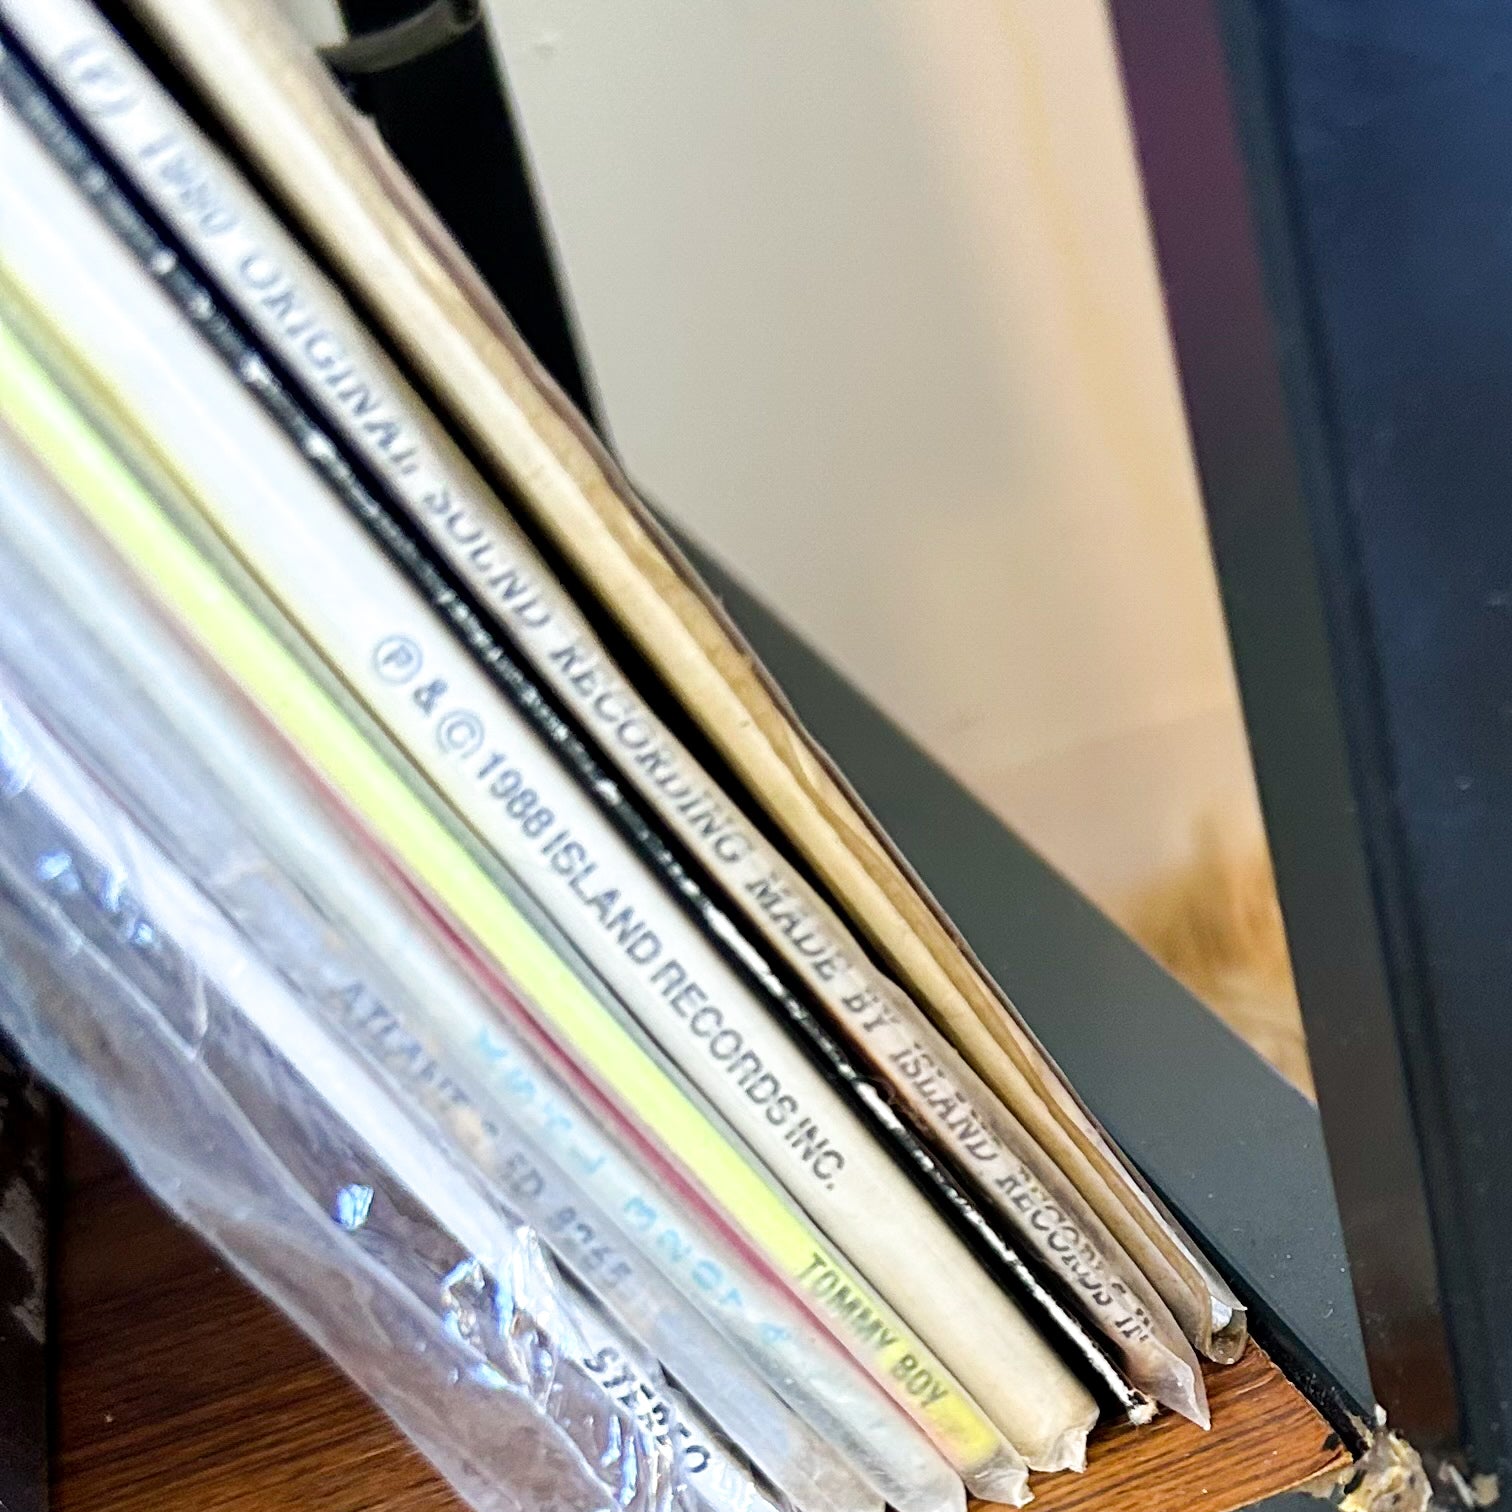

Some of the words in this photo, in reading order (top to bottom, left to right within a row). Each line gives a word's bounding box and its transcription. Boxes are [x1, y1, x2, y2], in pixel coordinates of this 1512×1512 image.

[238, 248, 422, 476] ORIGINAL
[423, 486, 552, 629] SOUND
[550, 642, 754, 865] RECORDING
[745, 872, 840, 982] MADE
[841, 988, 898, 1034] BY
[890, 1041, 999, 1163] ISLAND
[996, 1164, 1127, 1307] RECORDS
[413, 678, 448, 717] &
[477, 752, 555, 838] 1988
[541, 829, 663, 965] ISLAND
[650, 959, 799, 1127] RECORDS
[784, 1117, 845, 1191] INC.
[583, 1346, 711, 1473] STEREO
[799, 1252, 899, 1348] TOMMY
[890, 1353, 949, 1408] BOY
